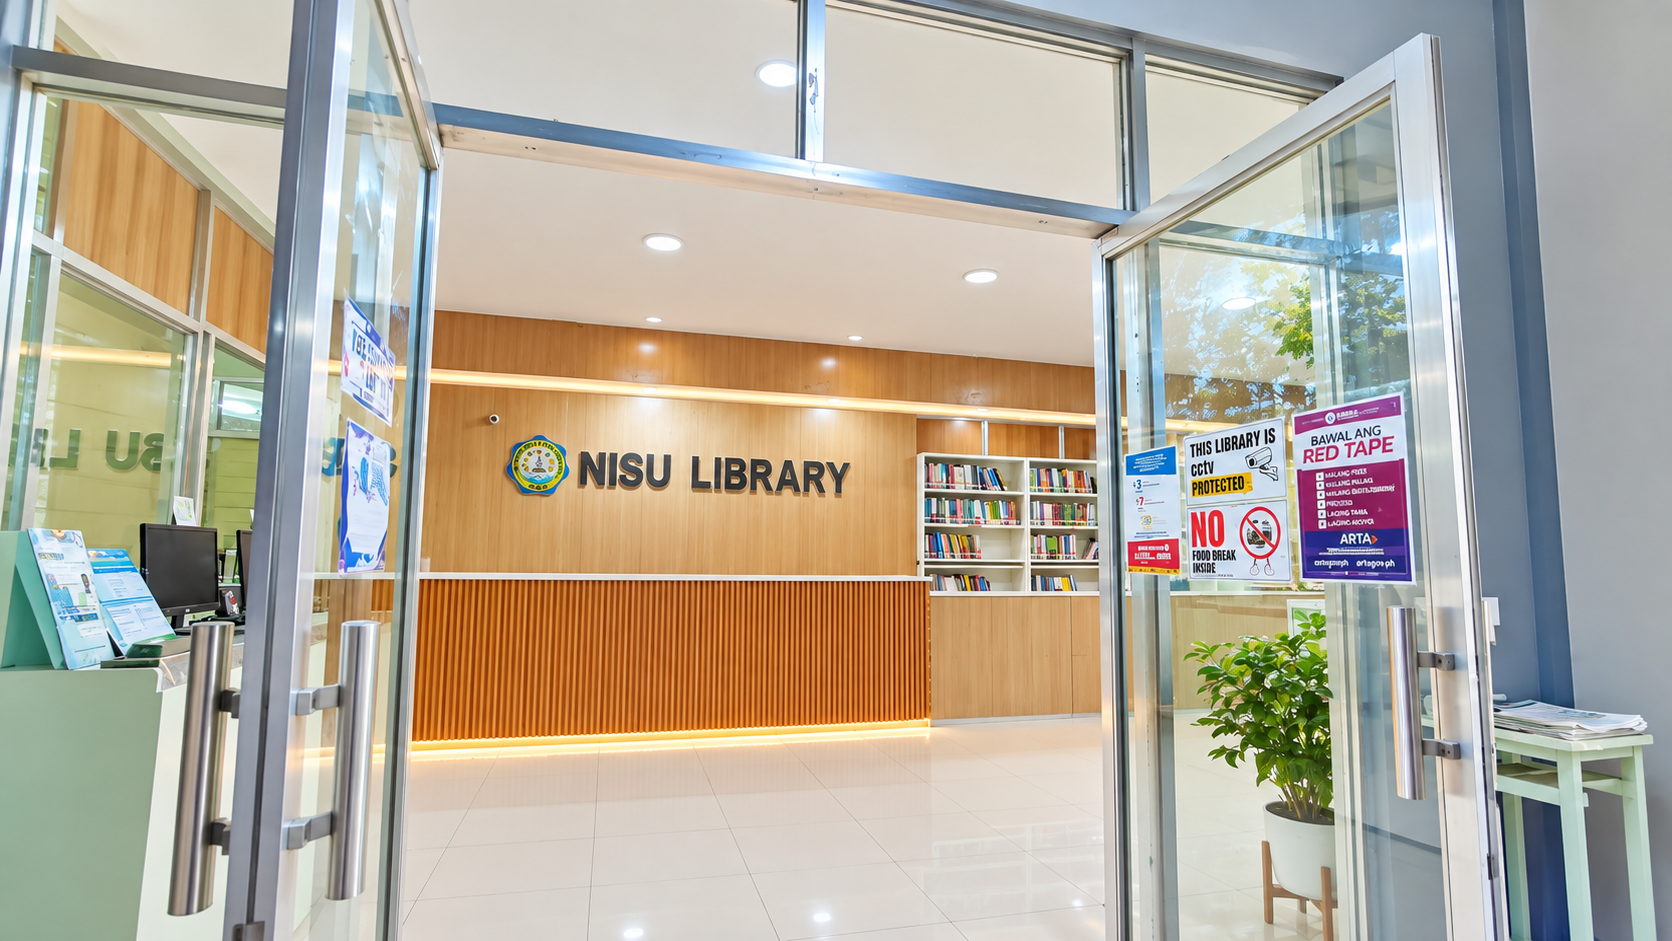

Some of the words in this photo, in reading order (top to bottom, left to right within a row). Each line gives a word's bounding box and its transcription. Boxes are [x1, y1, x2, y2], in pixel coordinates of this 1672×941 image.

[1190, 441, 1212, 458] THIS
[1215, 430, 1260, 453] LIBRARY
[1264, 428, 1276, 444] IS
[1311, 430, 1352, 446] BAWAL
[1354, 425, 1382, 439] ANG
[1303, 445, 1339, 464] RED
[1344, 436, 1395, 458] TAPE
[579, 450, 672, 489] NISU
[691, 455, 851, 494] LIBRARY
[1192, 475, 1245, 496] PROTECTED
[1191, 509, 1225, 548] NO
[1340, 533, 1372, 544] ARTA
[1212, 549, 1237, 561] BREAK
